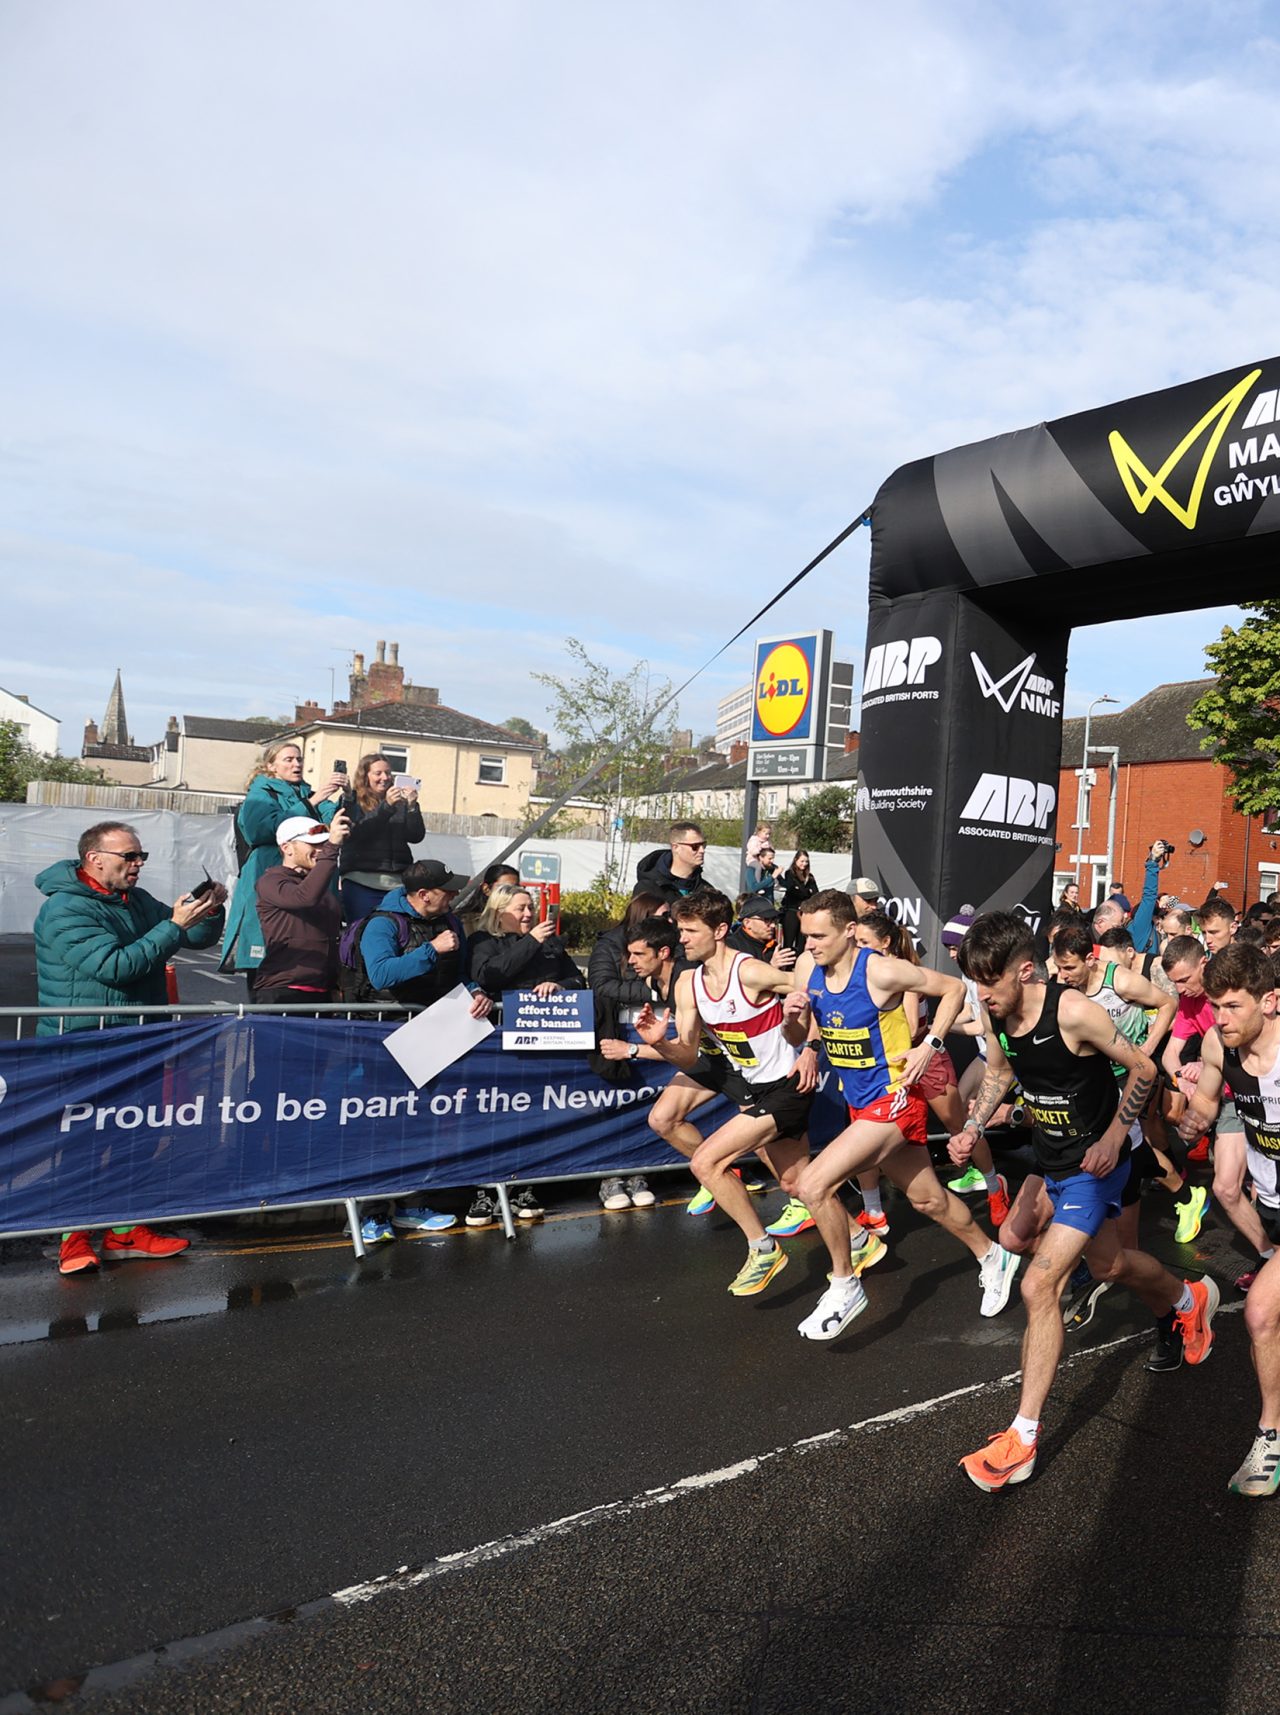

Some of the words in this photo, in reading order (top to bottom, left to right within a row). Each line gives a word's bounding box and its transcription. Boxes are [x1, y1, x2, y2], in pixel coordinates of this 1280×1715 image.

[862, 636, 943, 696] ABP
[1024, 673, 1055, 696] ABP
[885, 691, 911, 703] BRITISH
[911, 690, 939, 700] PORTS
[1020, 691, 1061, 718] NMF
[871, 786, 933, 798] Monmouthshire
[870, 799, 896, 811] Building
[896, 798, 927, 811] Society
[959, 772, 1056, 830] ABP
[958, 826, 1011, 840] ASSOCIATED
[1012, 832, 1038, 844] BRITISH
[1038, 836, 1054, 846] PORTS
[518, 992, 537, 1002] It's
[548, 993, 564, 1003] lot
[565, 993, 578, 1003] of
[518, 1005, 551, 1015] effort
[552, 1006, 570, 1016] for
[571, 1008, 579, 1016] a
[515, 1018, 539, 1028] free
[541, 1018, 582, 1028] banana
[826, 1041, 864, 1057] CARTER
[60, 1095, 205, 1132] Proud
[218, 1095, 262, 1124] to
[275, 1092, 327, 1121] be
[339, 1090, 419, 1125] part
[429, 1087, 467, 1115] of
[477, 1086, 532, 1113] the
